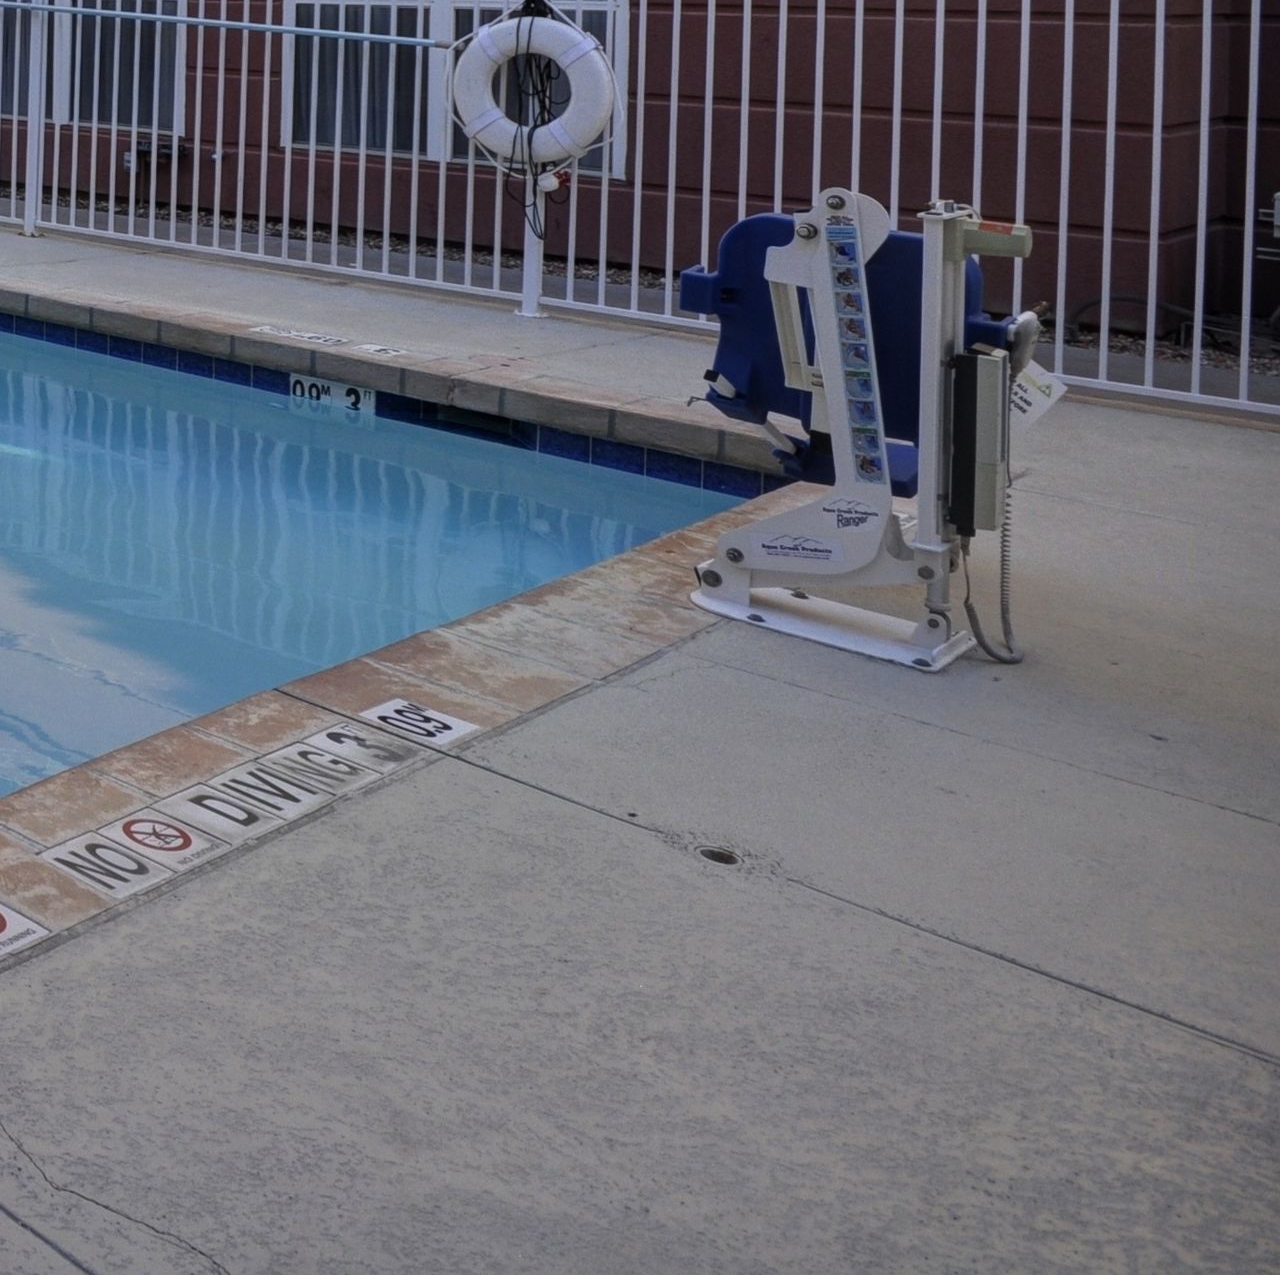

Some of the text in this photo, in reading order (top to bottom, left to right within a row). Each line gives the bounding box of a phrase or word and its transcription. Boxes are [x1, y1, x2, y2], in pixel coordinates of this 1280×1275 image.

[837, 514, 869, 528] Ranger
[801, 545, 833, 554] Products
[53, 843, 150, 890] NO
[188, 750, 364, 827] DIVING
